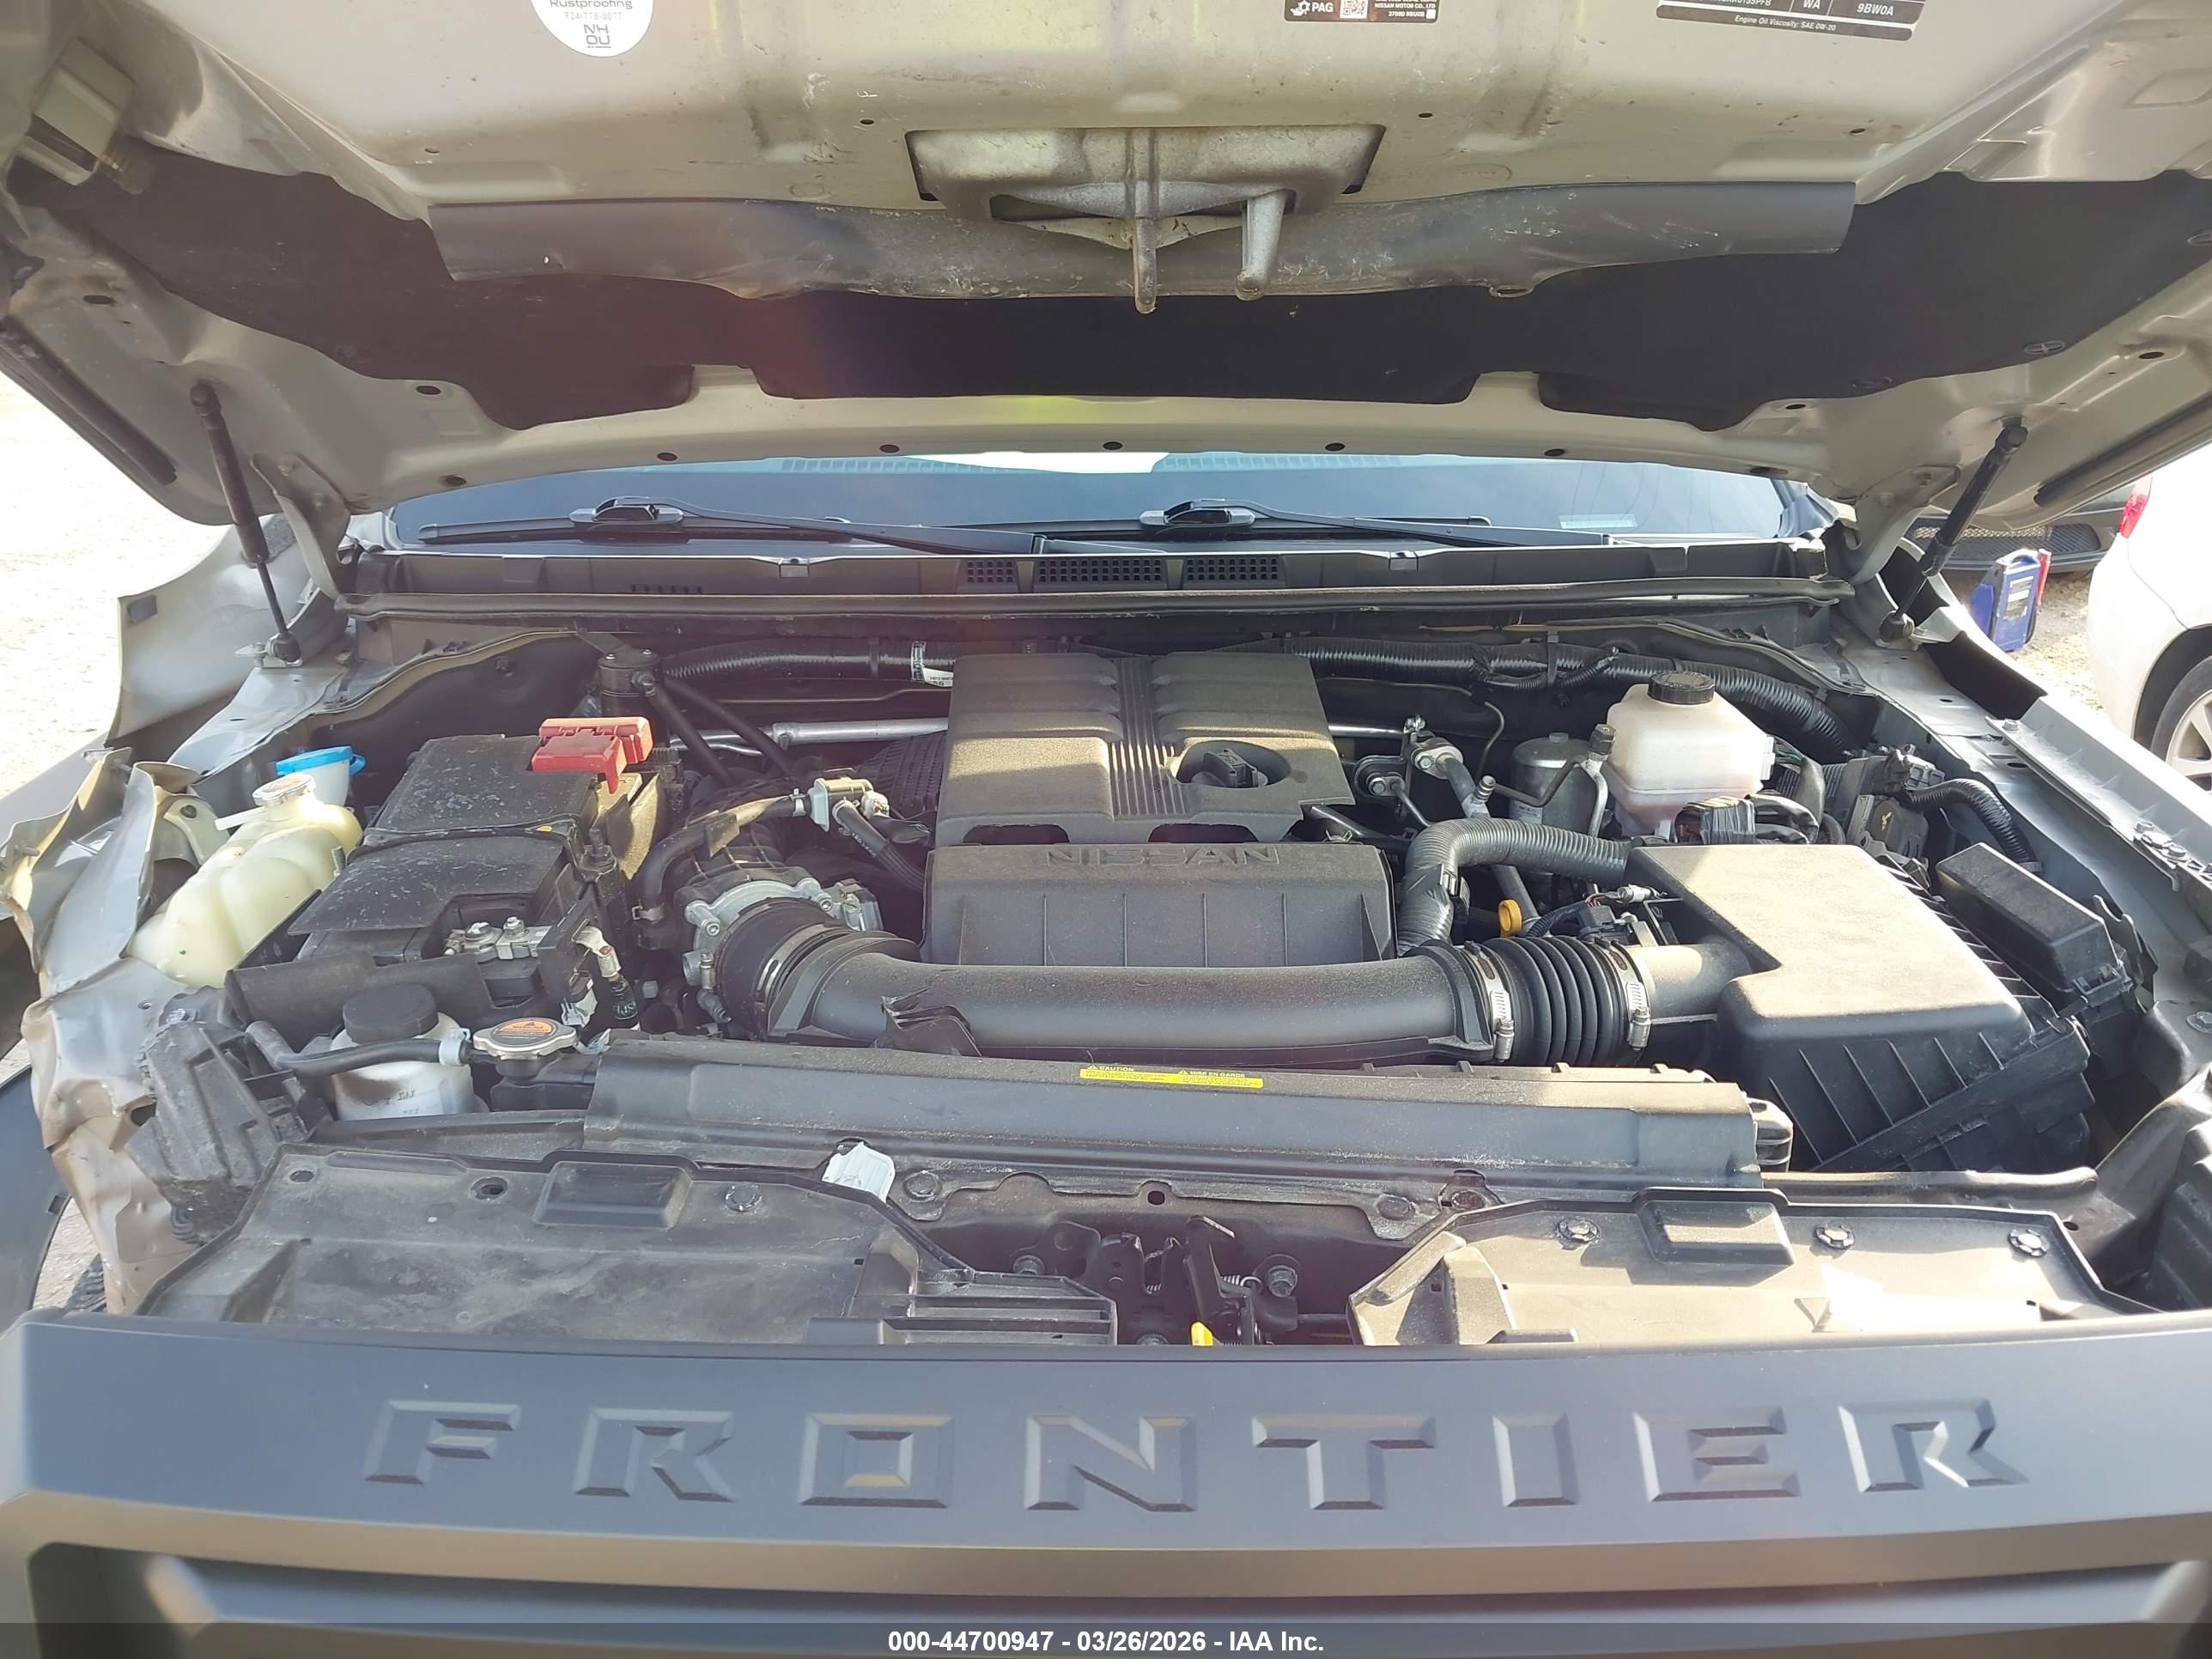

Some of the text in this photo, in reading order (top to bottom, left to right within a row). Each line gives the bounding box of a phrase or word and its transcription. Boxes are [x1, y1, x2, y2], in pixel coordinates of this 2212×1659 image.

[550, 0, 632, 9] Rustproofing
[1312, 2, 1334, 12] PAG
[1803, 0, 1821, 9] WA
[1735, 15, 1758, 24] Engine
[1769, 18, 1800, 28] Viscosity:
[1801, 21, 1815, 29] SAE
[1047, 847, 1280, 866] NISSAN
[364, 1399, 2030, 1512] FRONTIER
